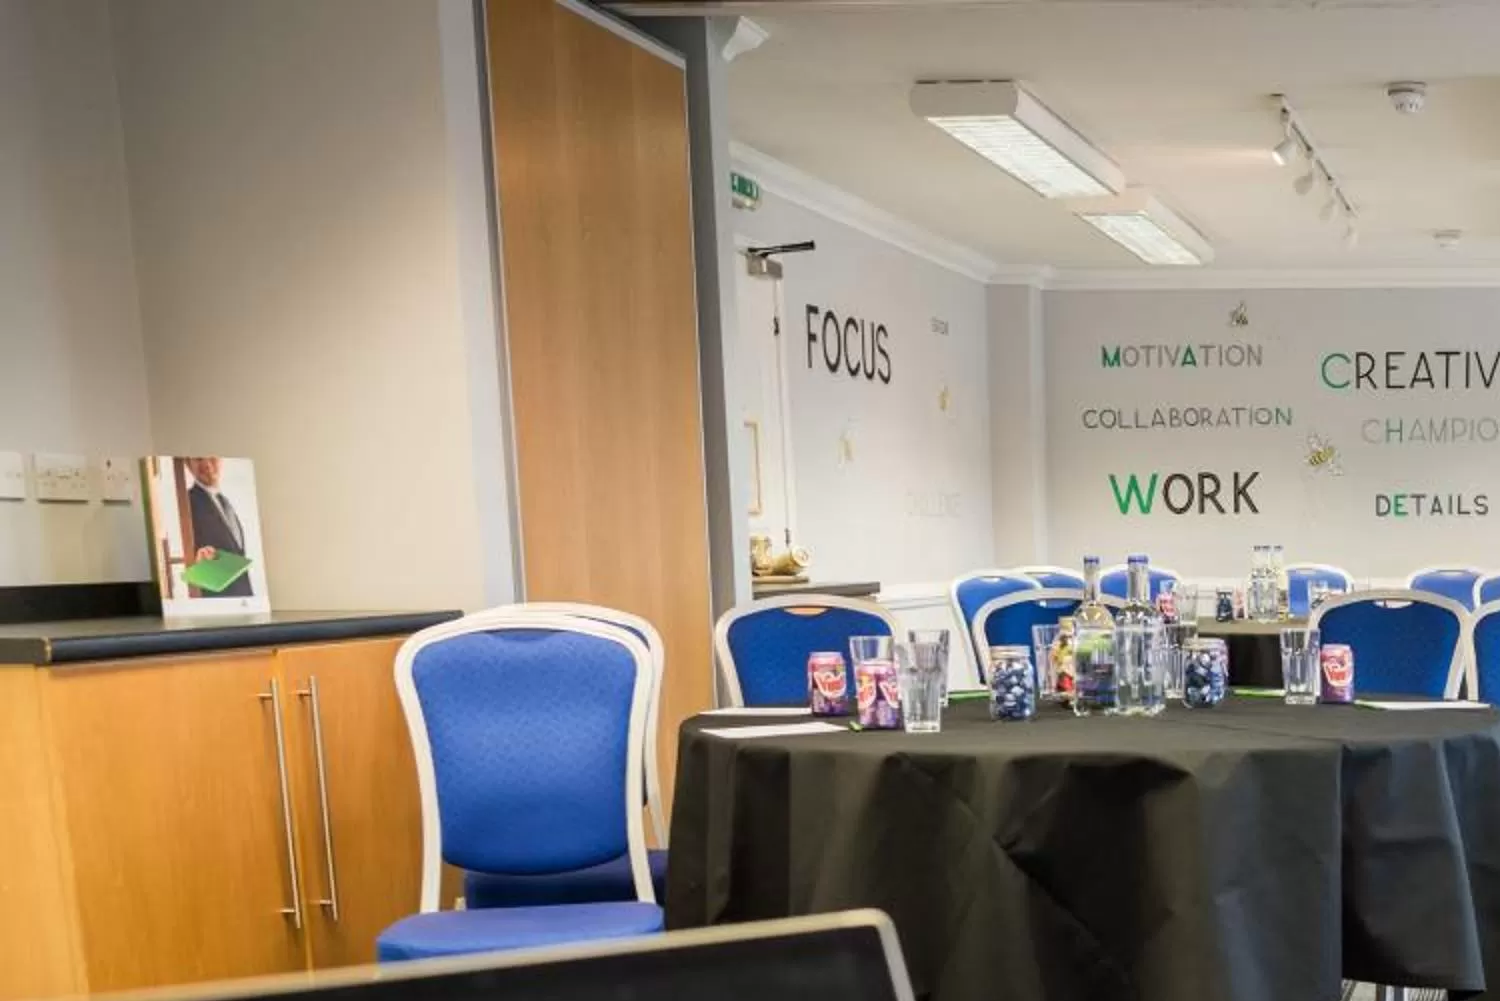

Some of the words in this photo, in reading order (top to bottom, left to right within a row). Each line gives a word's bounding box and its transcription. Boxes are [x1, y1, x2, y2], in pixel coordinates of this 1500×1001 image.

[805, 304, 892, 384] FOCUS
[1101, 344, 1263, 368] MOTIVATION
[1082, 407, 1293, 429] COLLABORATION
[1108, 470, 1260, 515] WORK
[1375, 494, 1489, 517] DETAILS
